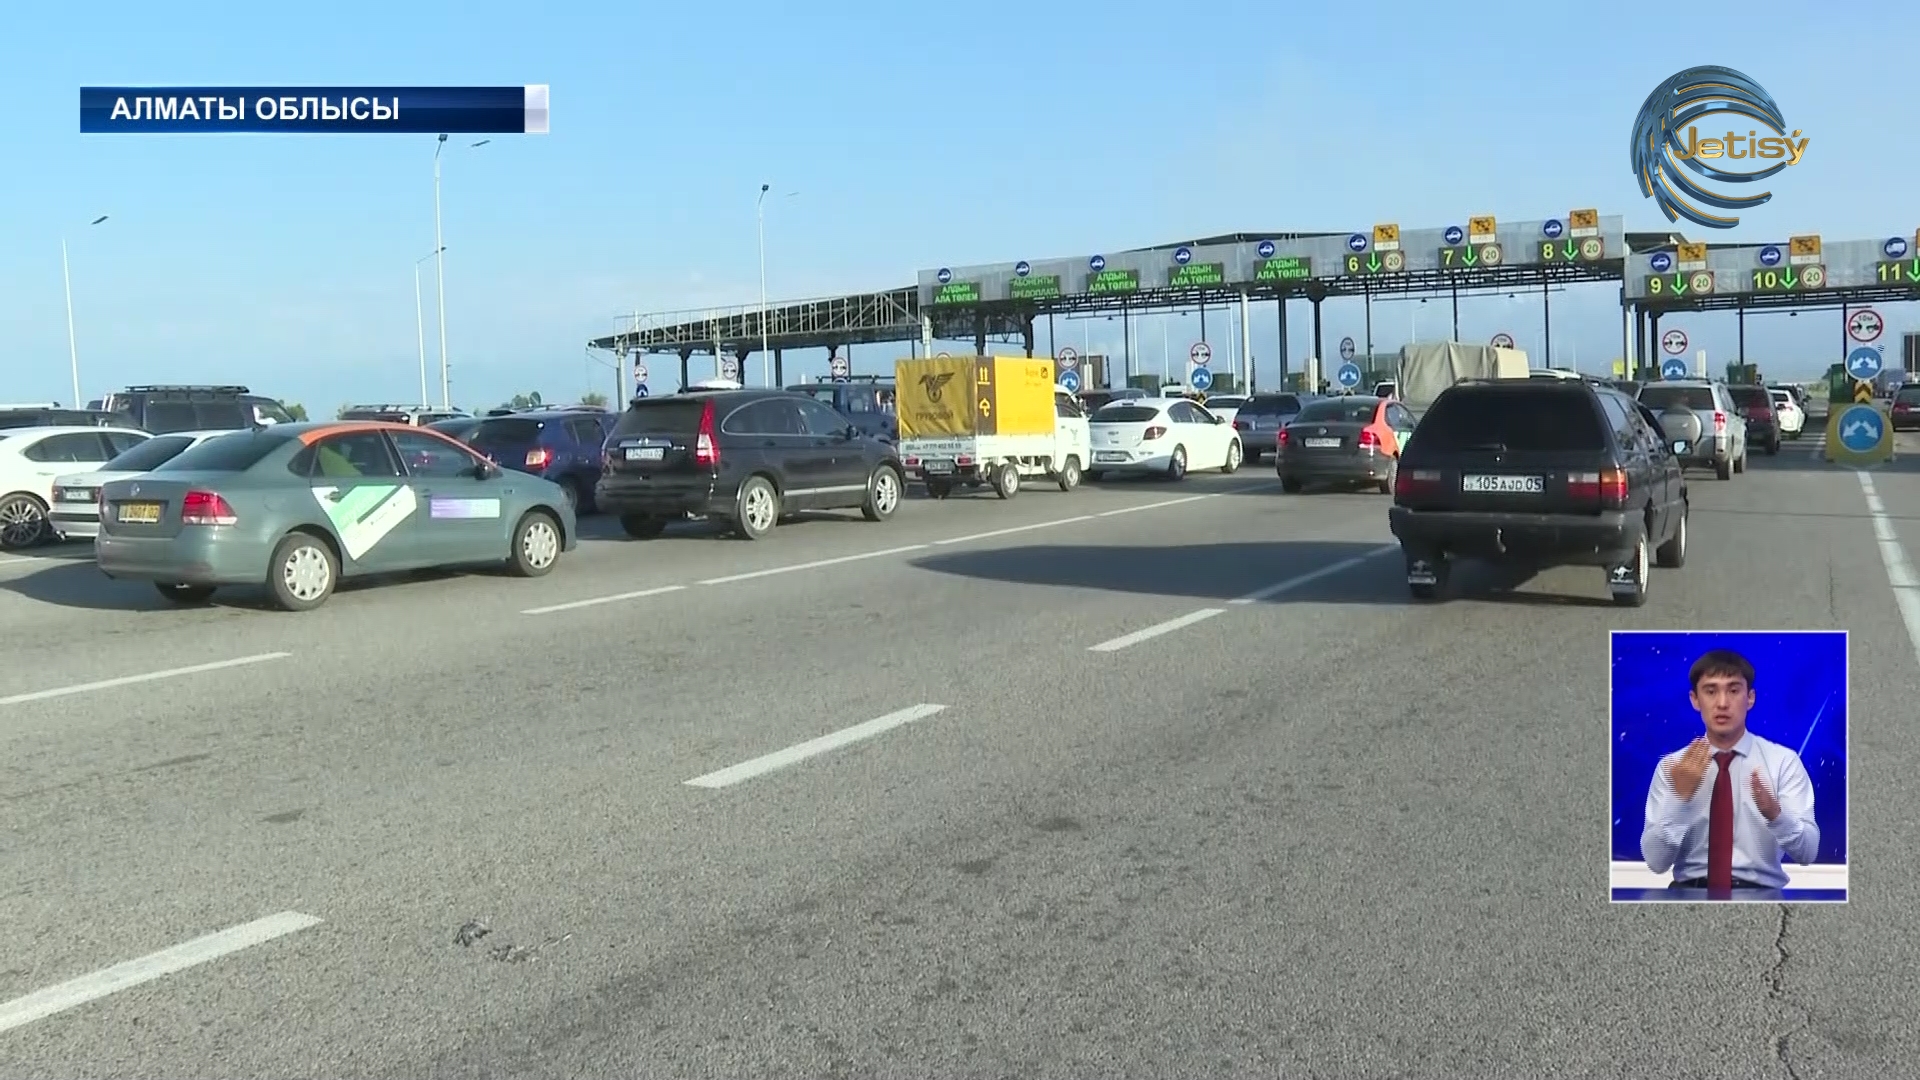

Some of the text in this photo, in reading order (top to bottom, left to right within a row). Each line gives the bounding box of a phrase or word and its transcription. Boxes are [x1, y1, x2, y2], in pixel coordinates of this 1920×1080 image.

[1485, 249, 1497, 260] 20
[1543, 243, 1554, 259] 8
[1586, 244, 1598, 254] 20
[1388, 257, 1399, 266] 20
[1443, 249, 1454, 265] 7
[1180, 264, 1212, 275] АЛДЫН
[1265, 259, 1299, 270] АЛДЫН
[1348, 257, 1359, 272] 6
[1097, 271, 1128, 281] АЛДЫН
[1257, 268, 1309, 280] АЛА ТӨЛЕМ
[1806, 272, 1820, 282] 20
[1878, 263, 1900, 281] 11
[1171, 274, 1221, 286] АЛА ТӨЛЕМ
[1695, 278, 1709, 289] 20
[1753, 271, 1777, 289] 10
[1089, 282, 1107, 292] АЛА
[1650, 278, 1662, 294] 9
[935, 294, 951, 304] АЛА
[1477, 476, 1498, 489] 105
[1500, 479, 1522, 490] AJD
[1526, 478, 1542, 491] 05
